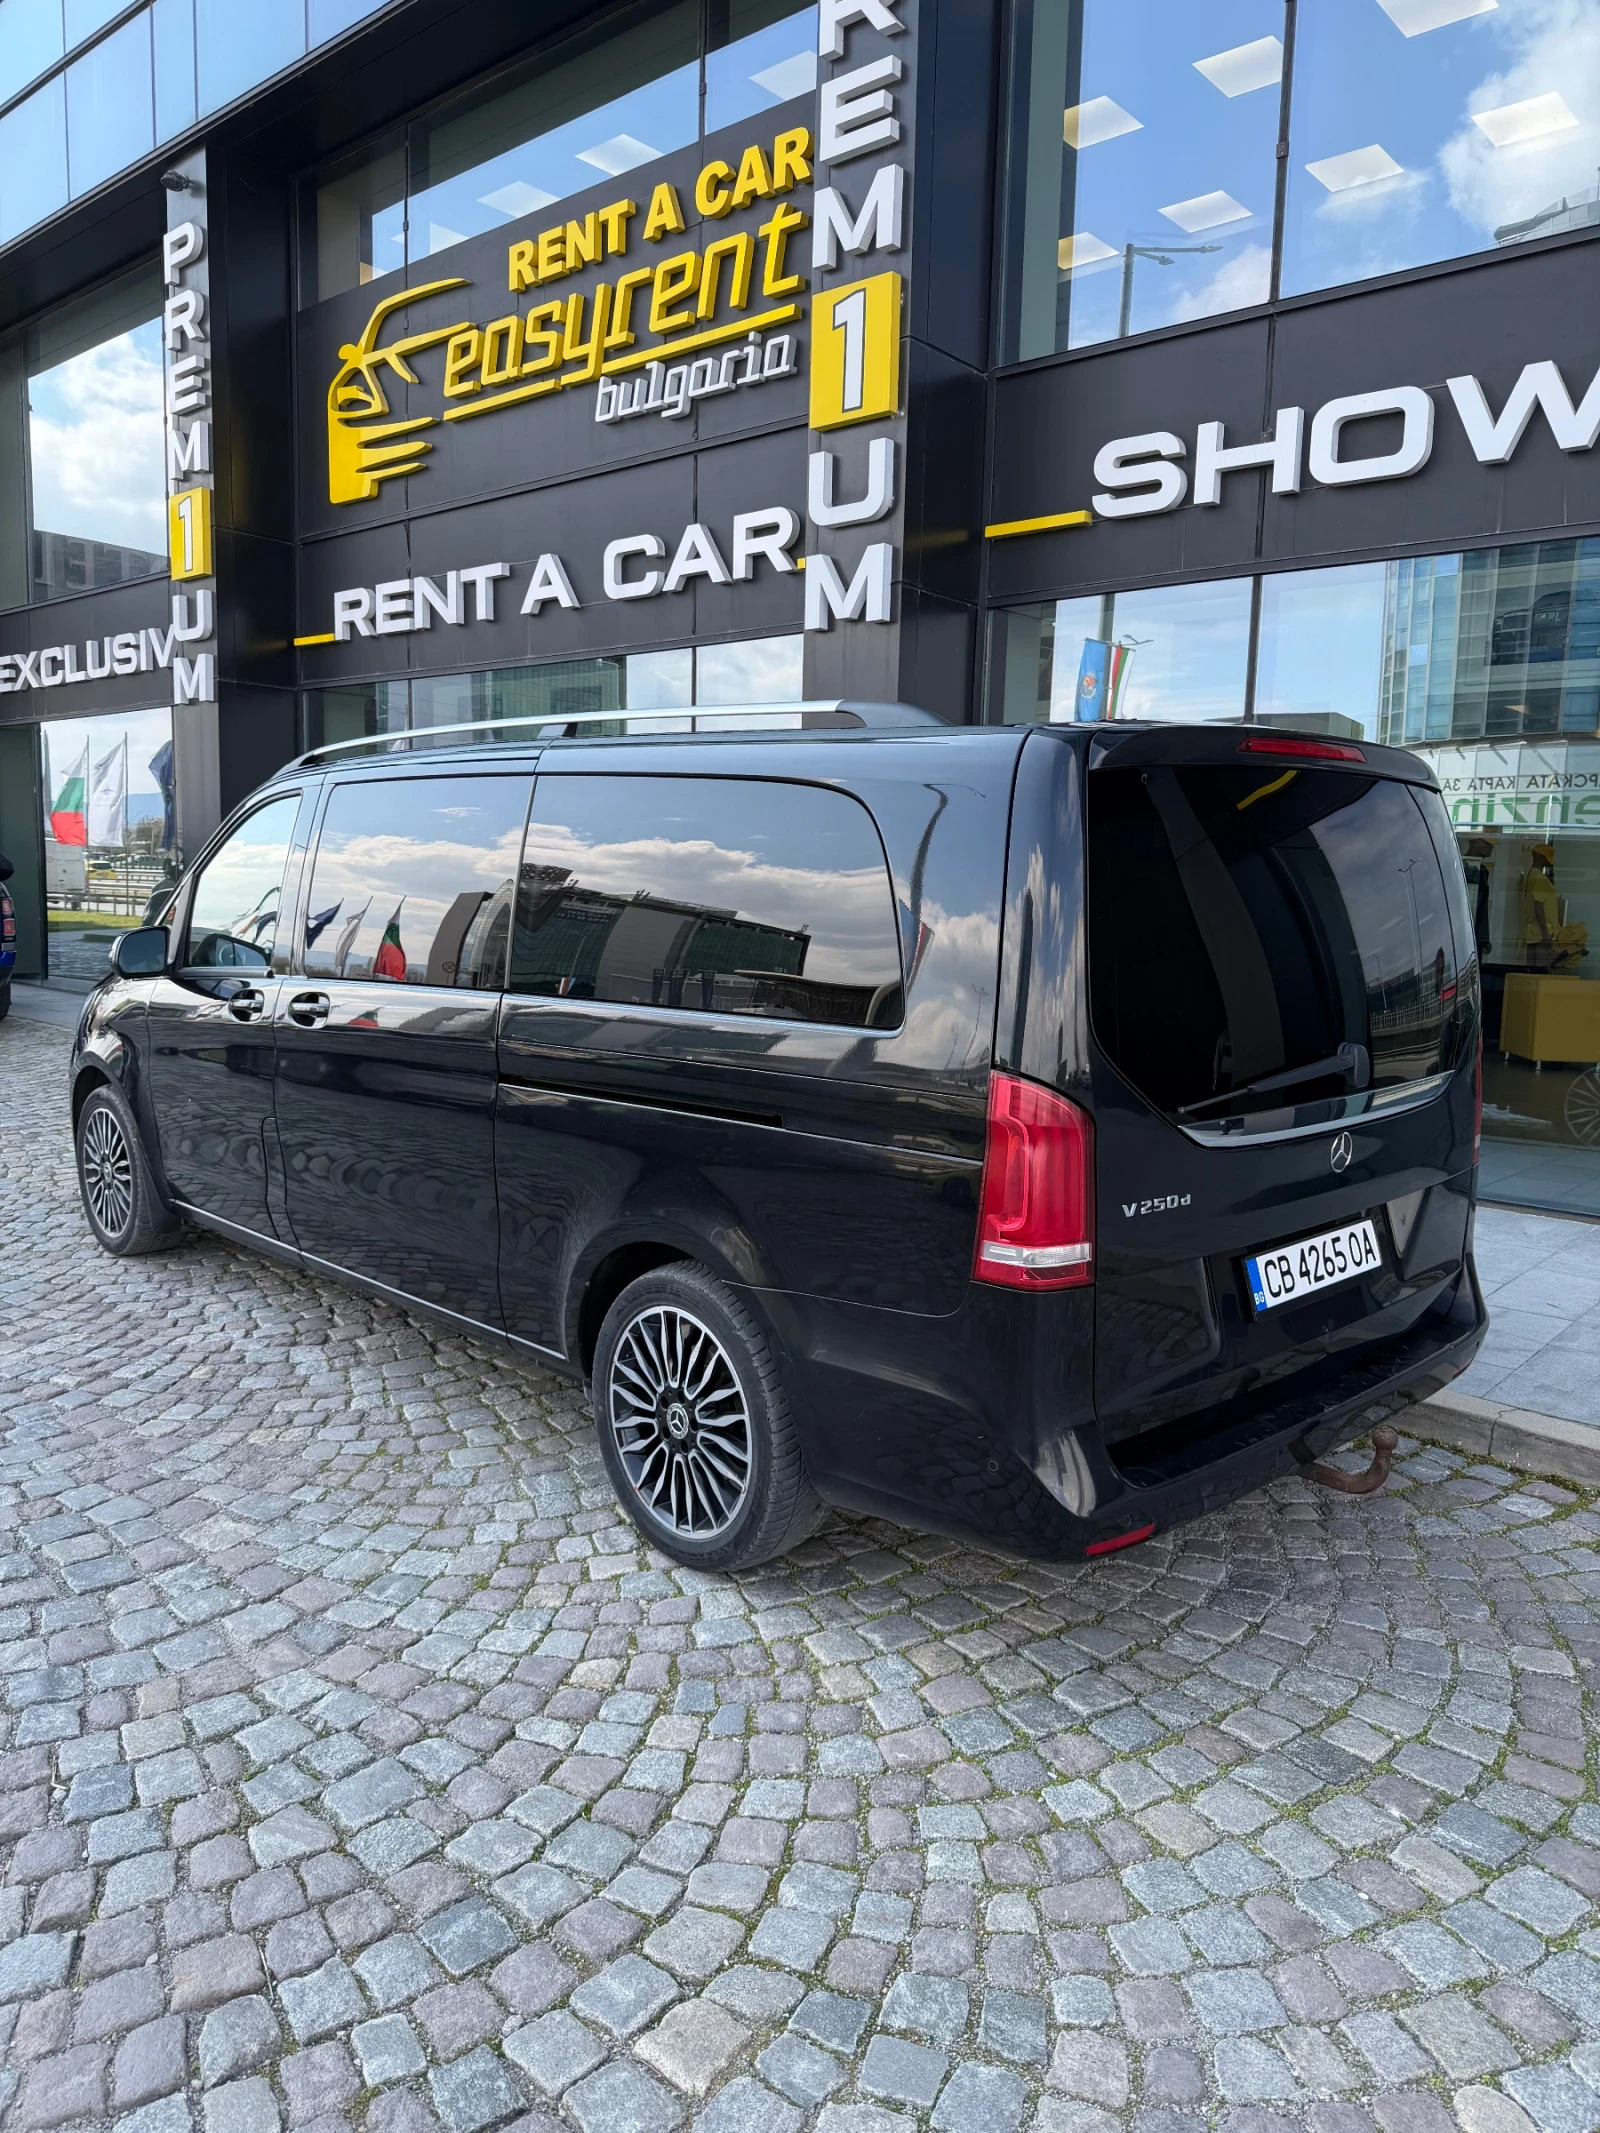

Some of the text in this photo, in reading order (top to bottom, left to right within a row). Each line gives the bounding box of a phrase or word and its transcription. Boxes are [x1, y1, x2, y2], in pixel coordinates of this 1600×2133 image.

[508, 127, 814, 293] RENT A CAR
[444, 203, 810, 399] easyrent
[595, 331, 797, 424] bulgaria
[1092, 360, 1600, 519] SHOW
[162, 222, 214, 704] PREM1UM
[334, 506, 800, 642] RENT A CAR
[1253, 1291, 1265, 1305] BG
[1263, 1254, 1296, 1299] CB
[1299, 1235, 1348, 1286] 4265
